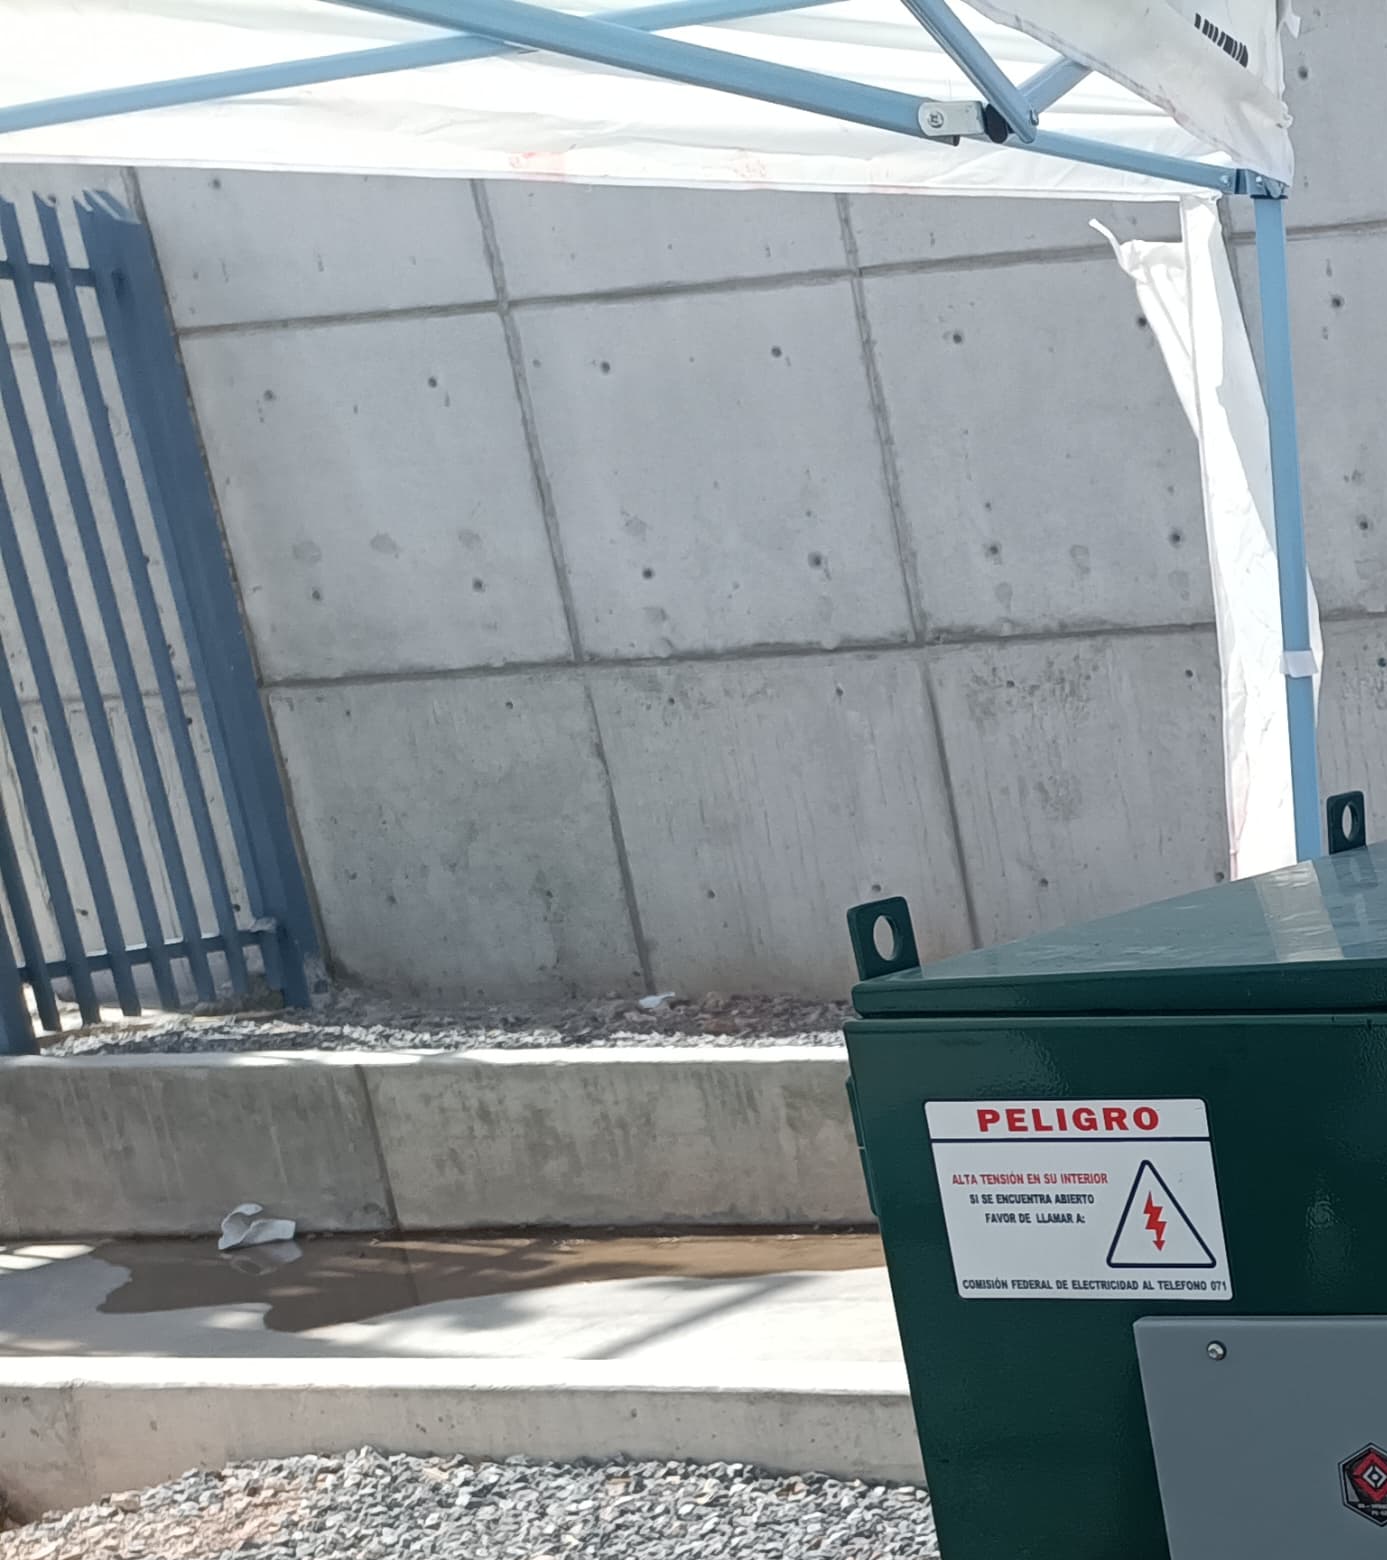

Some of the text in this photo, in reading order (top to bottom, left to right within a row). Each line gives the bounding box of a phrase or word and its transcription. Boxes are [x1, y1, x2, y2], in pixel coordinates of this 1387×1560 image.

[976, 1106, 1159, 1133] PELIGRO
[952, 1170, 1108, 1185] ALTA TENSIÓN EN SU INTERIOR
[969, 1194, 1095, 1205] SI SE ENCUENTRA ABIERTO
[985, 1213, 1086, 1224] FAVOR DE LLAMAR A:
[962, 1277, 1227, 1292] COMISIÓN FEDERAL DE ELECTRICIDAD AL TELEFONO 071
